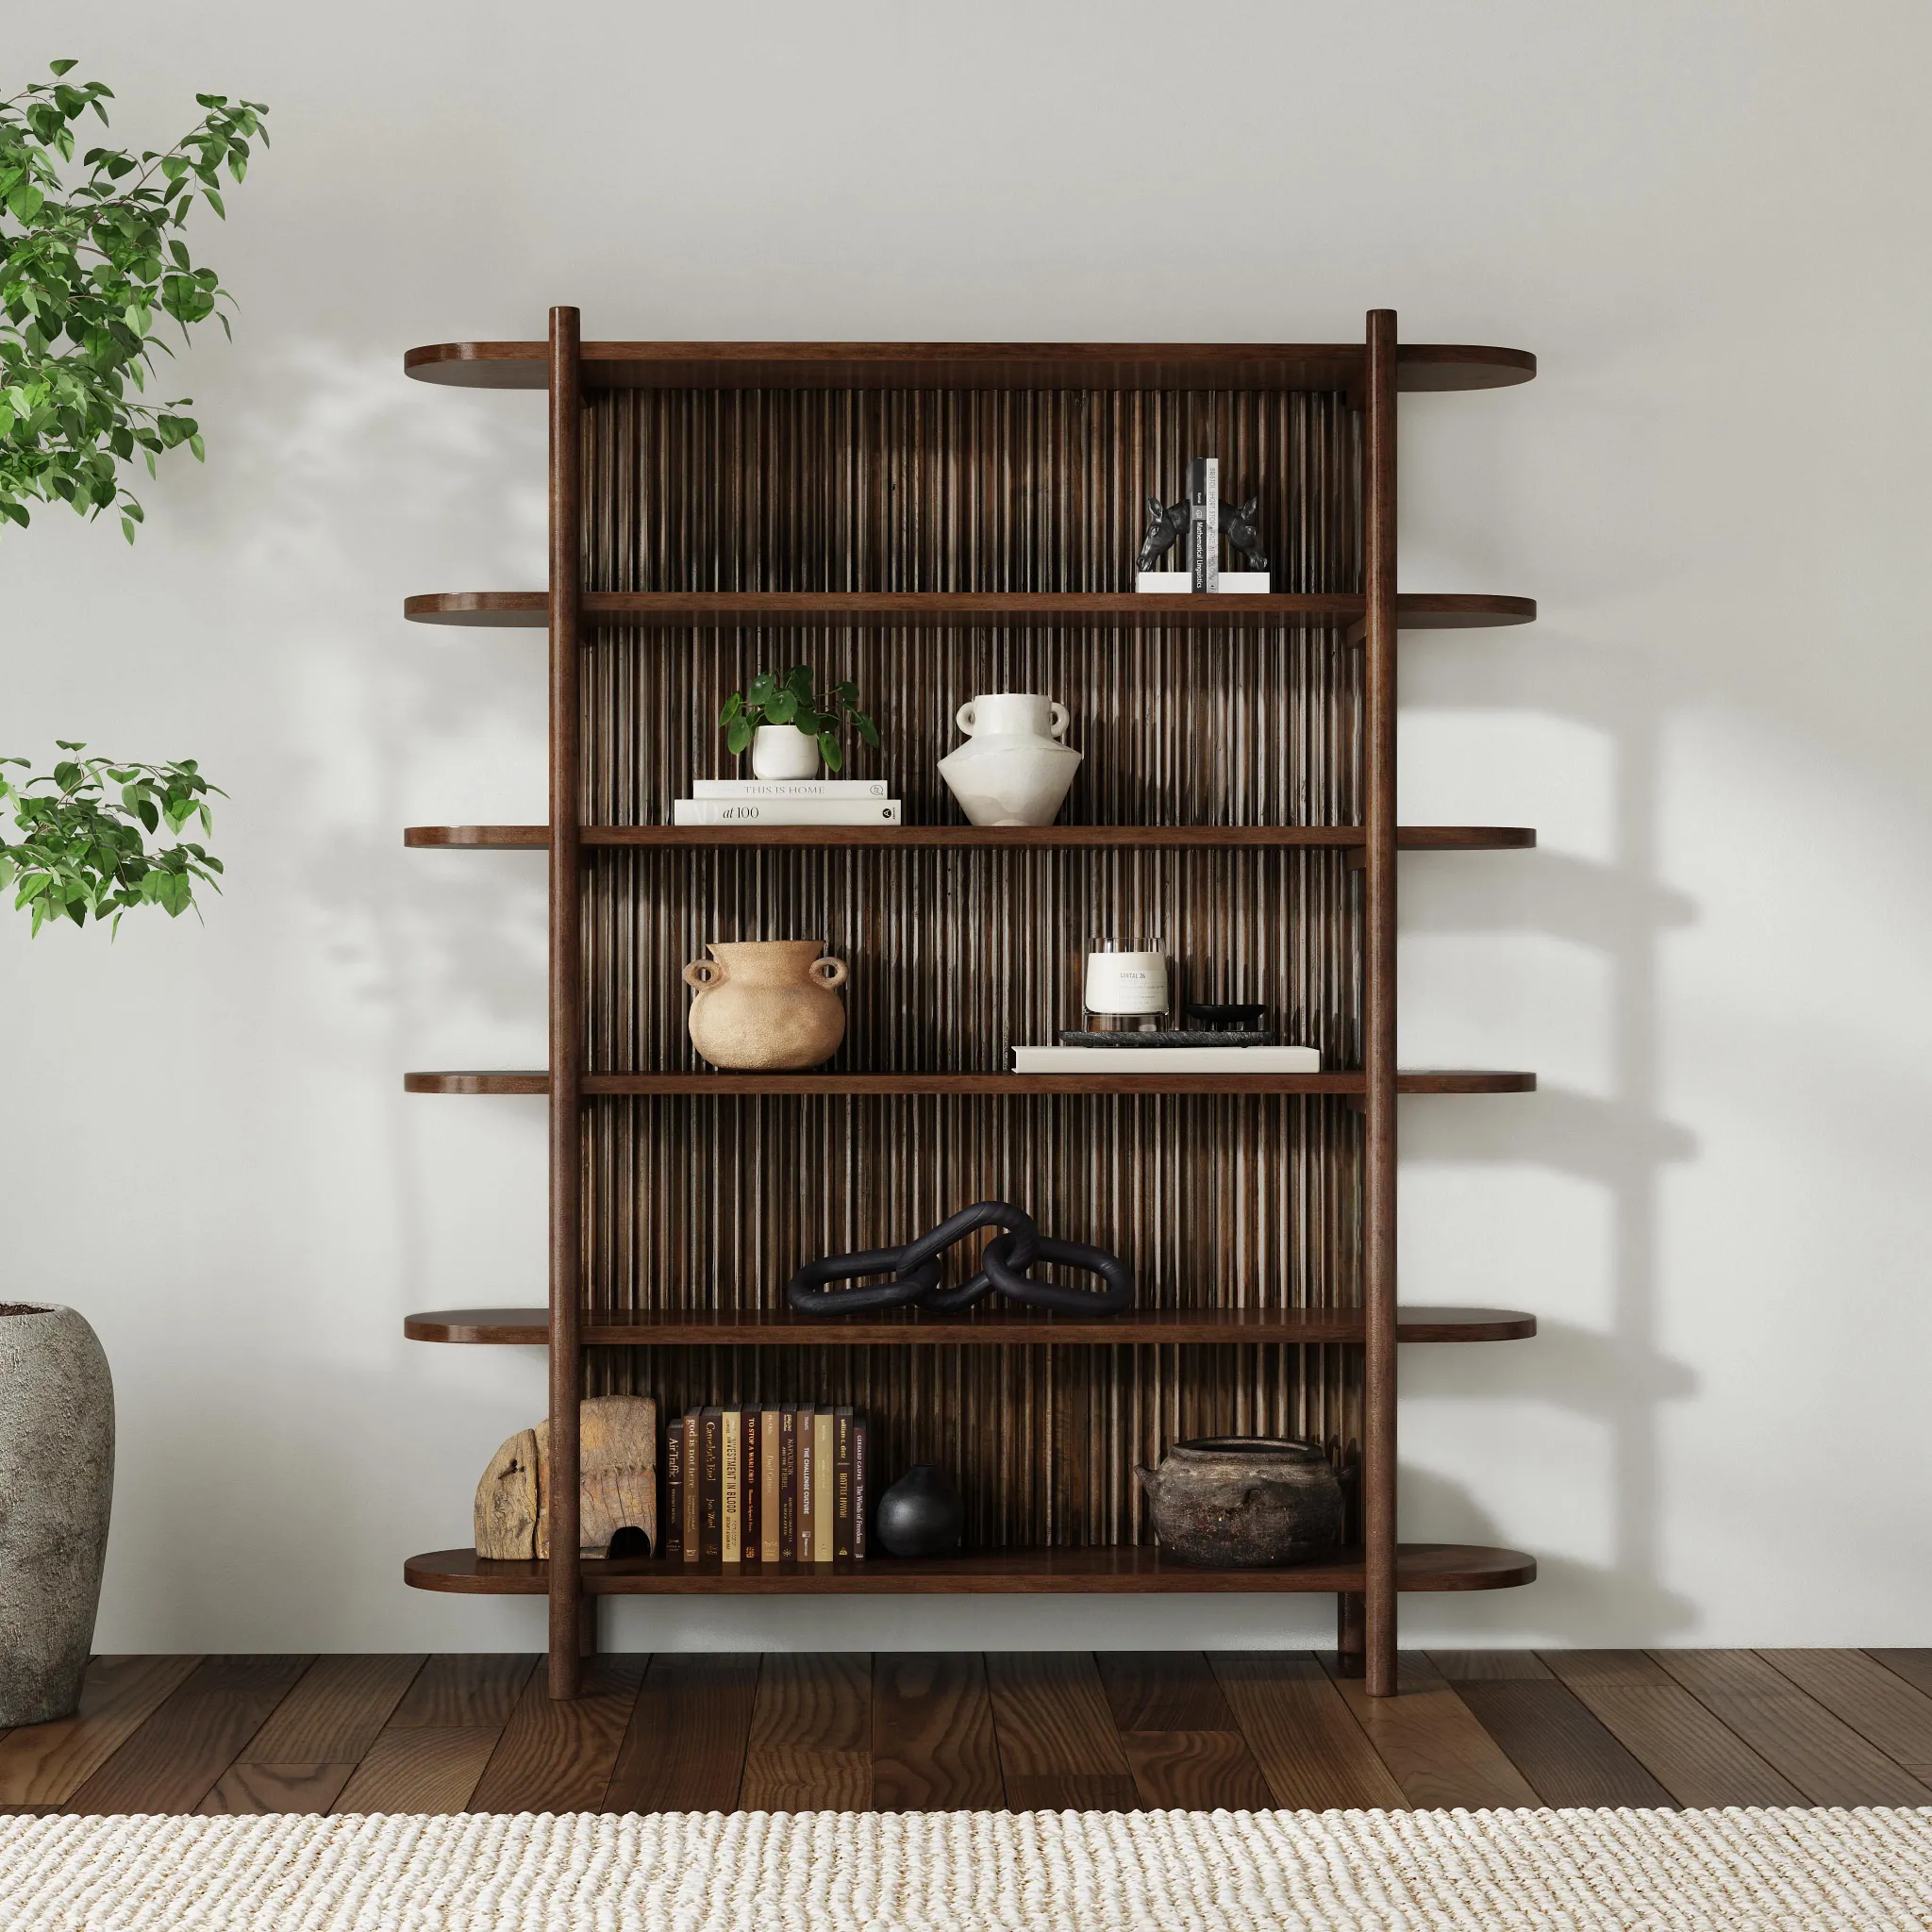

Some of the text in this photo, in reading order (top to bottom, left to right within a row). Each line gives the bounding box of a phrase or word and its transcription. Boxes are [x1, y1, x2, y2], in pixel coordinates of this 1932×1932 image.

[743, 786, 772, 794] THIS
[775, 786, 785, 794] IS
[789, 786, 825, 794] HOME
[723, 808, 734, 819] at
[737, 807, 759, 819] 100
[686, 1419, 698, 1437] god
[748, 1417, 755, 1428] TO
[669, 1438, 678, 1477] Air Traffic
[689, 1449, 698, 1465] not
[706, 1421, 716, 1481] Camelot's End
[726, 1437, 736, 1479] INVESTMENT
[689, 1468, 698, 1489] here
[726, 1492, 736, 1513] BLOOD
